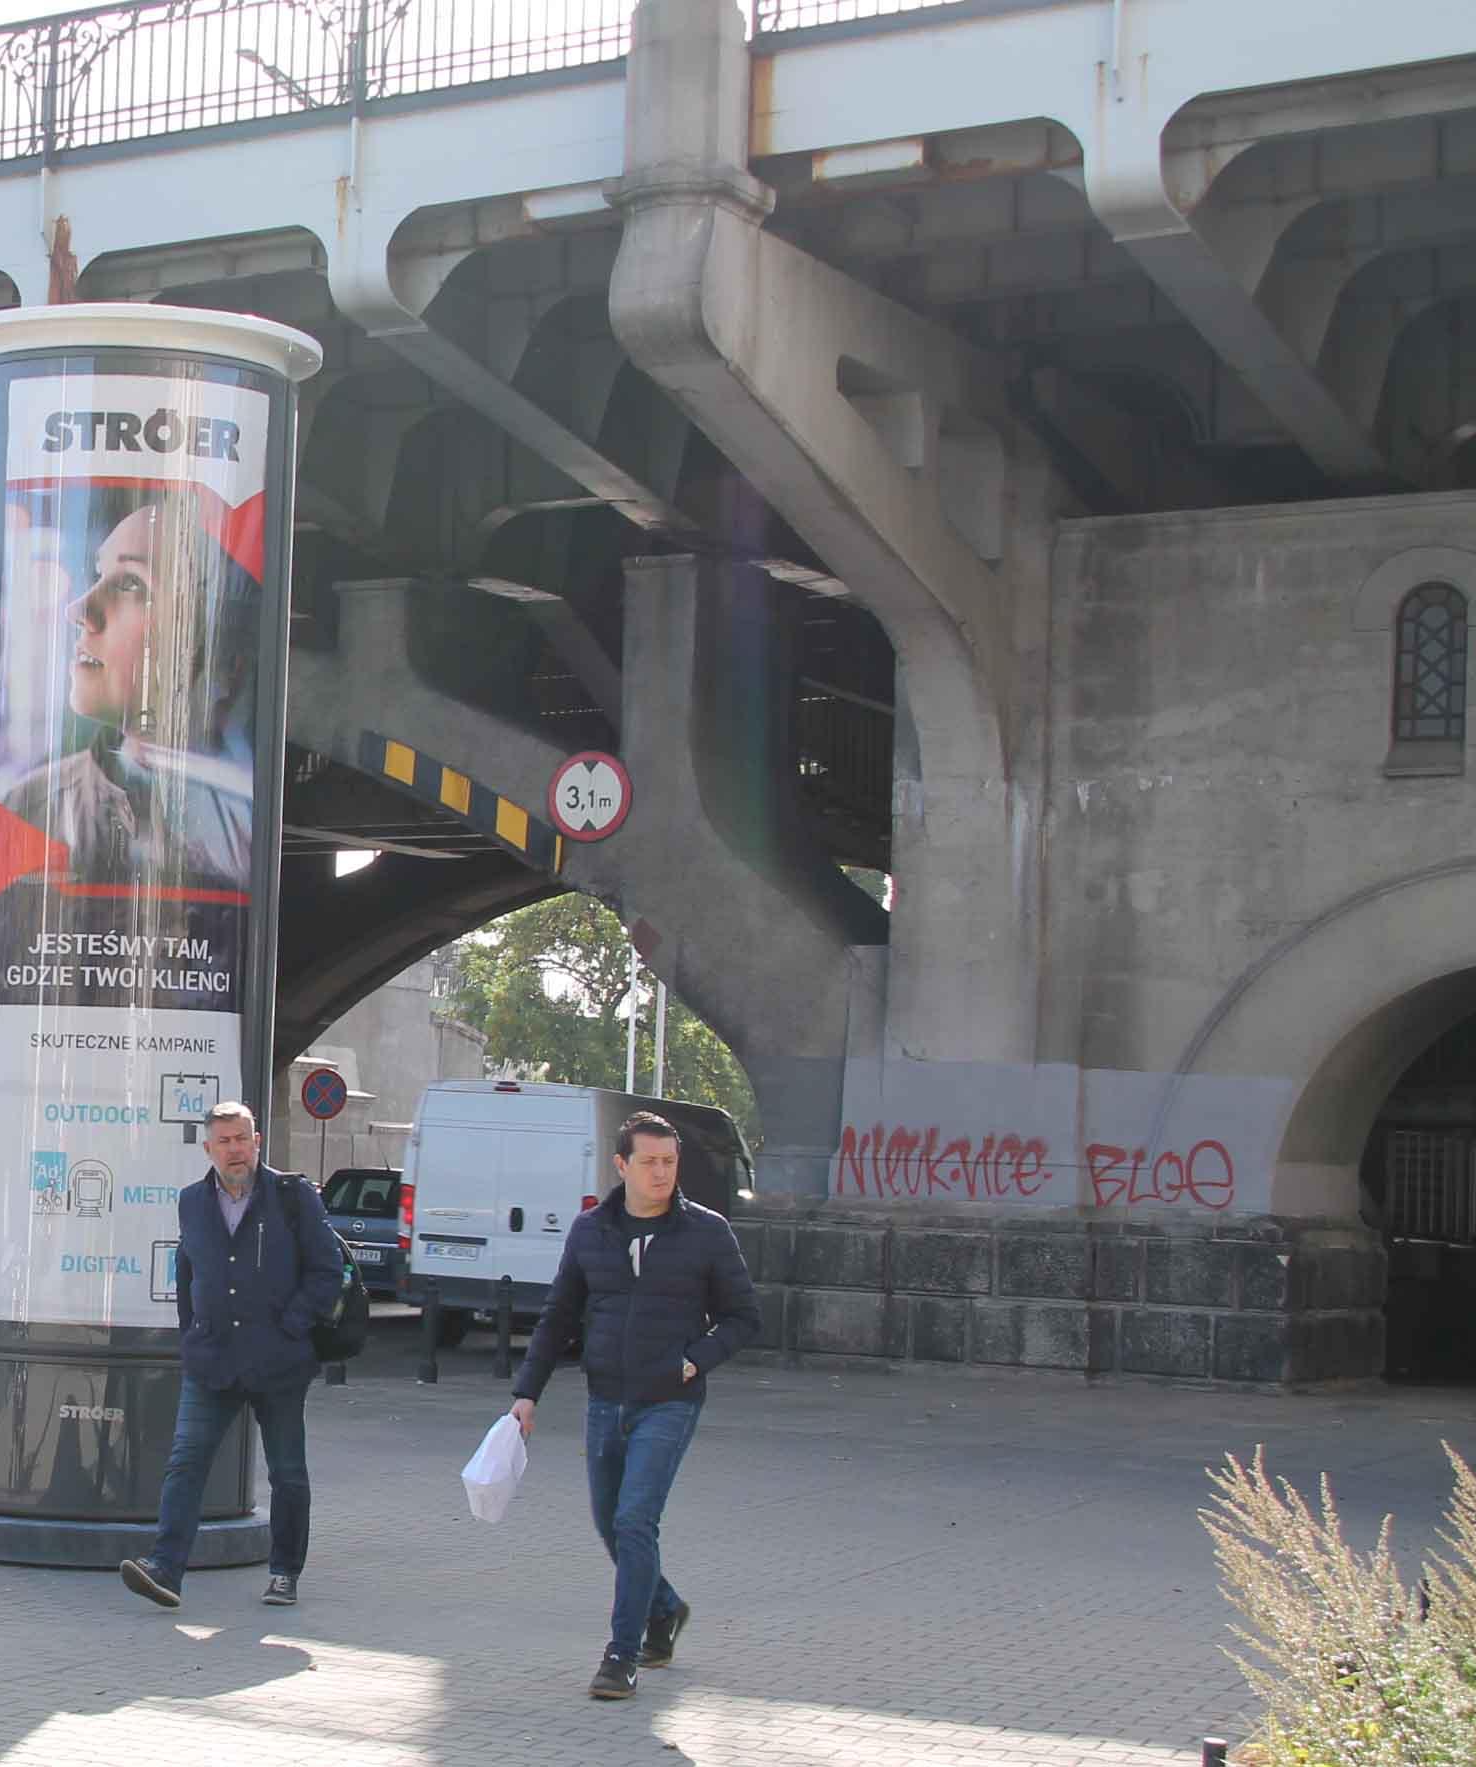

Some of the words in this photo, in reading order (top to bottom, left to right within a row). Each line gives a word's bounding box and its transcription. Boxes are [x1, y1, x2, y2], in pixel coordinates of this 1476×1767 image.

[41, 408, 240, 463] STRÖER
[28, 930, 158, 958] JESTEŚMY
[164, 936, 214, 964] TAM,
[6, 965, 75, 987] GDZIE
[80, 966, 145, 989] TWOI
[149, 968, 230, 993] KLIENCI
[30, 1032, 131, 1050] SKUTECZNE
[137, 1036, 217, 1054] KAMPANIE
[44, 1103, 151, 1125] OUTDOOR
[123, 1185, 180, 1205] METR
[59, 1253, 142, 1274] DIGITAL
